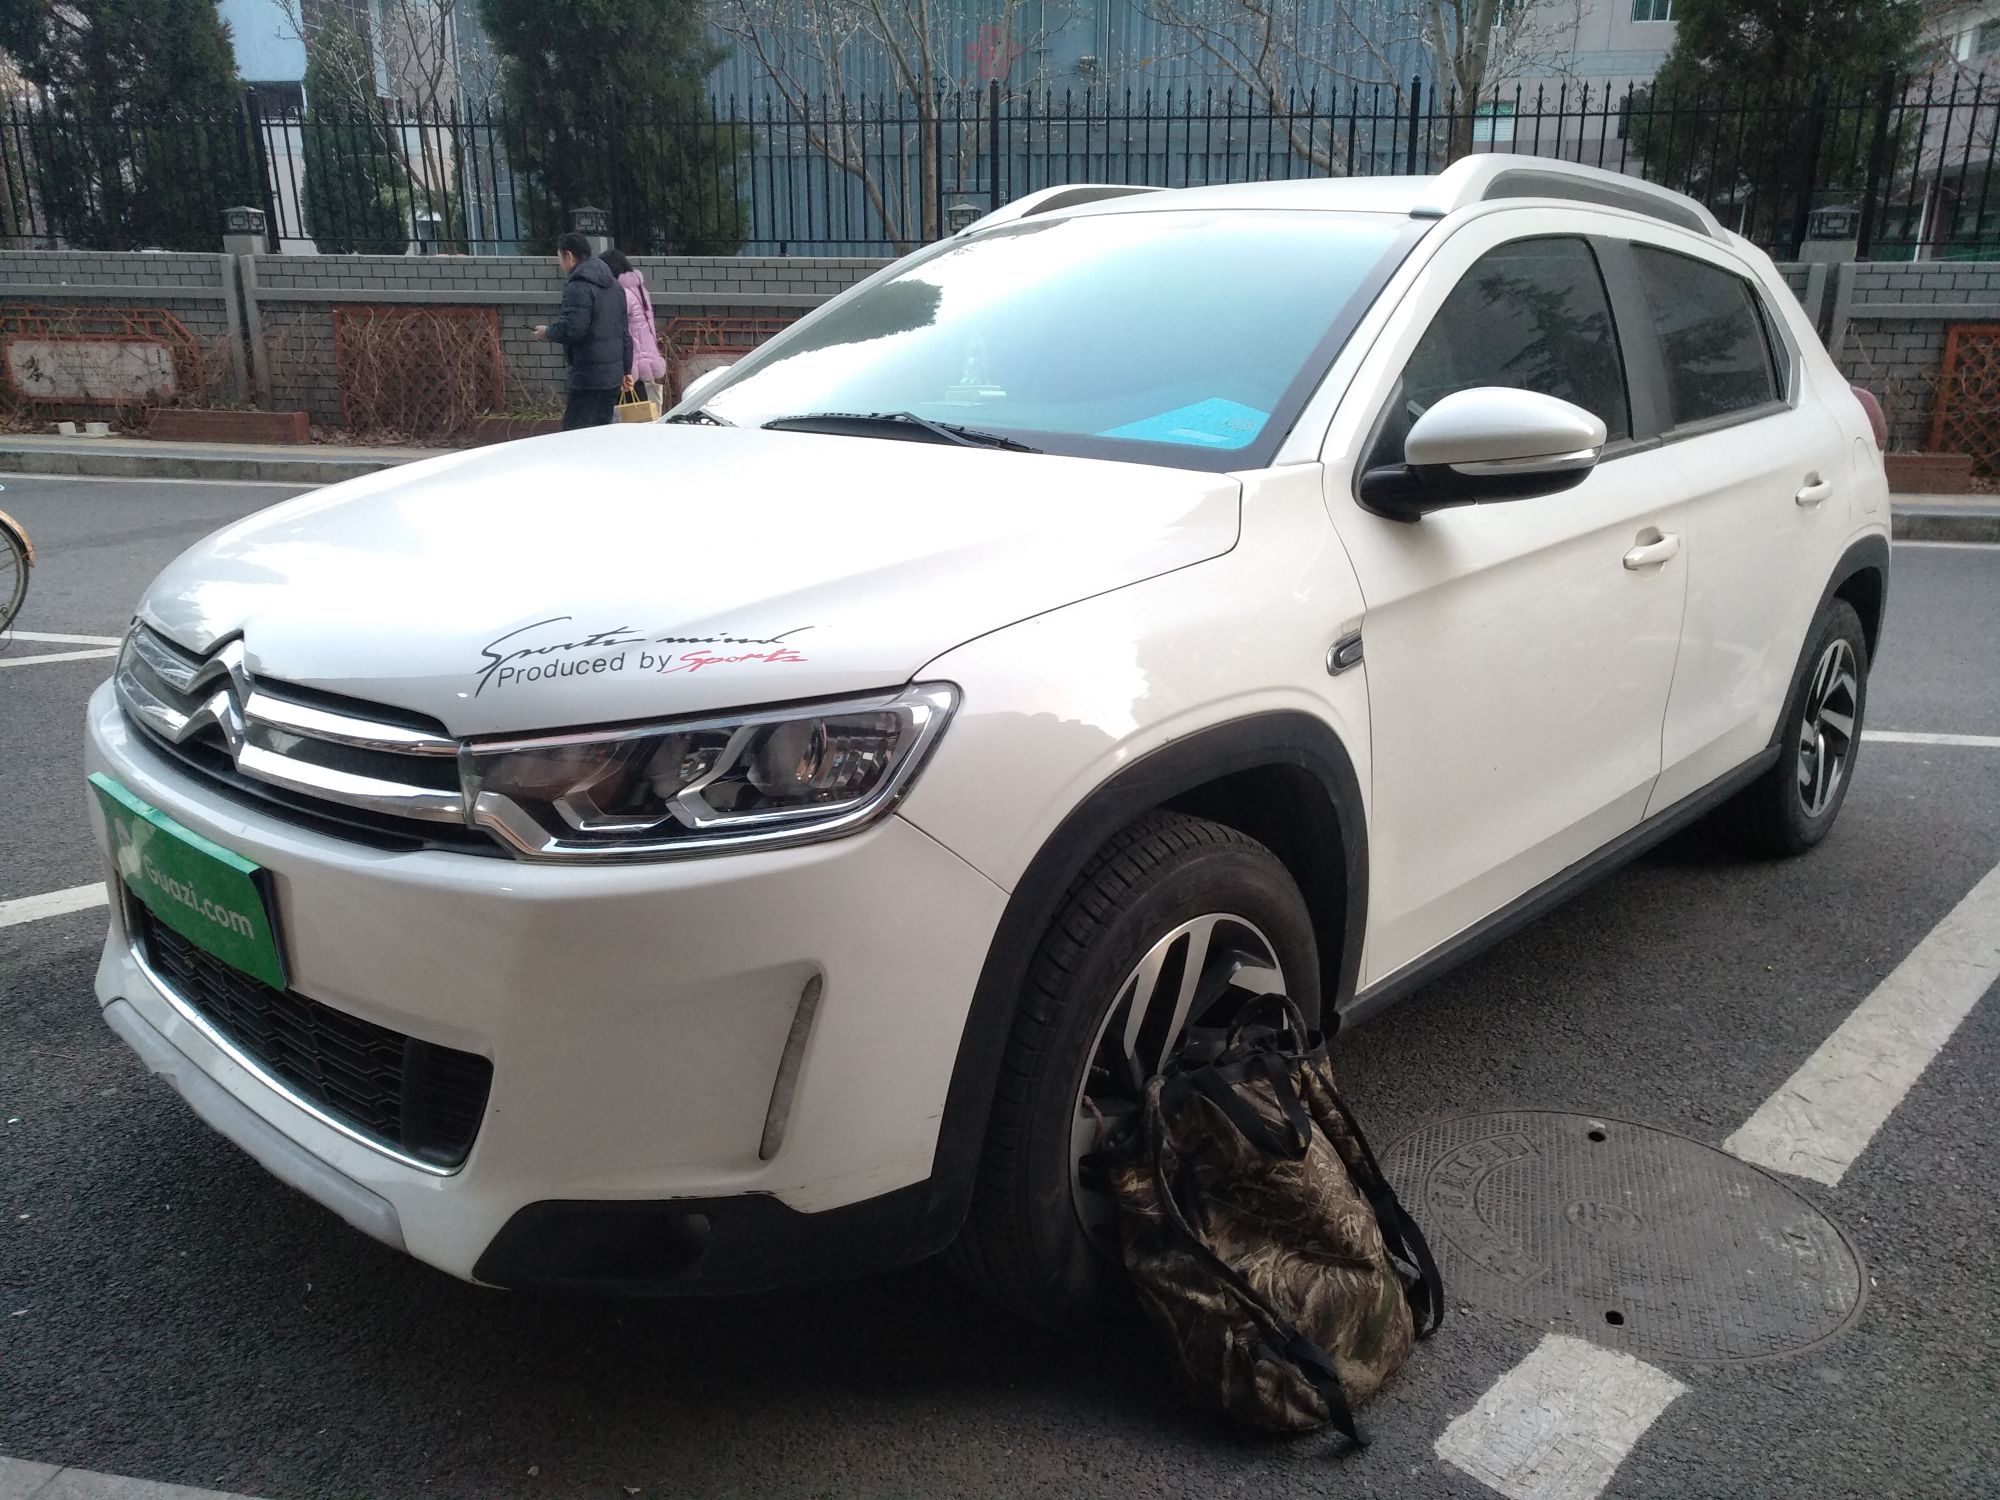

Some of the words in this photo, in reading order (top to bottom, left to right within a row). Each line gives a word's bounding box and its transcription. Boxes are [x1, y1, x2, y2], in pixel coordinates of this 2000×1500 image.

[497, 651, 625, 688] Produced
[639, 650, 673, 673] by
[662, 647, 809, 674] Sports
[143, 854, 255, 940] Guazi.com
